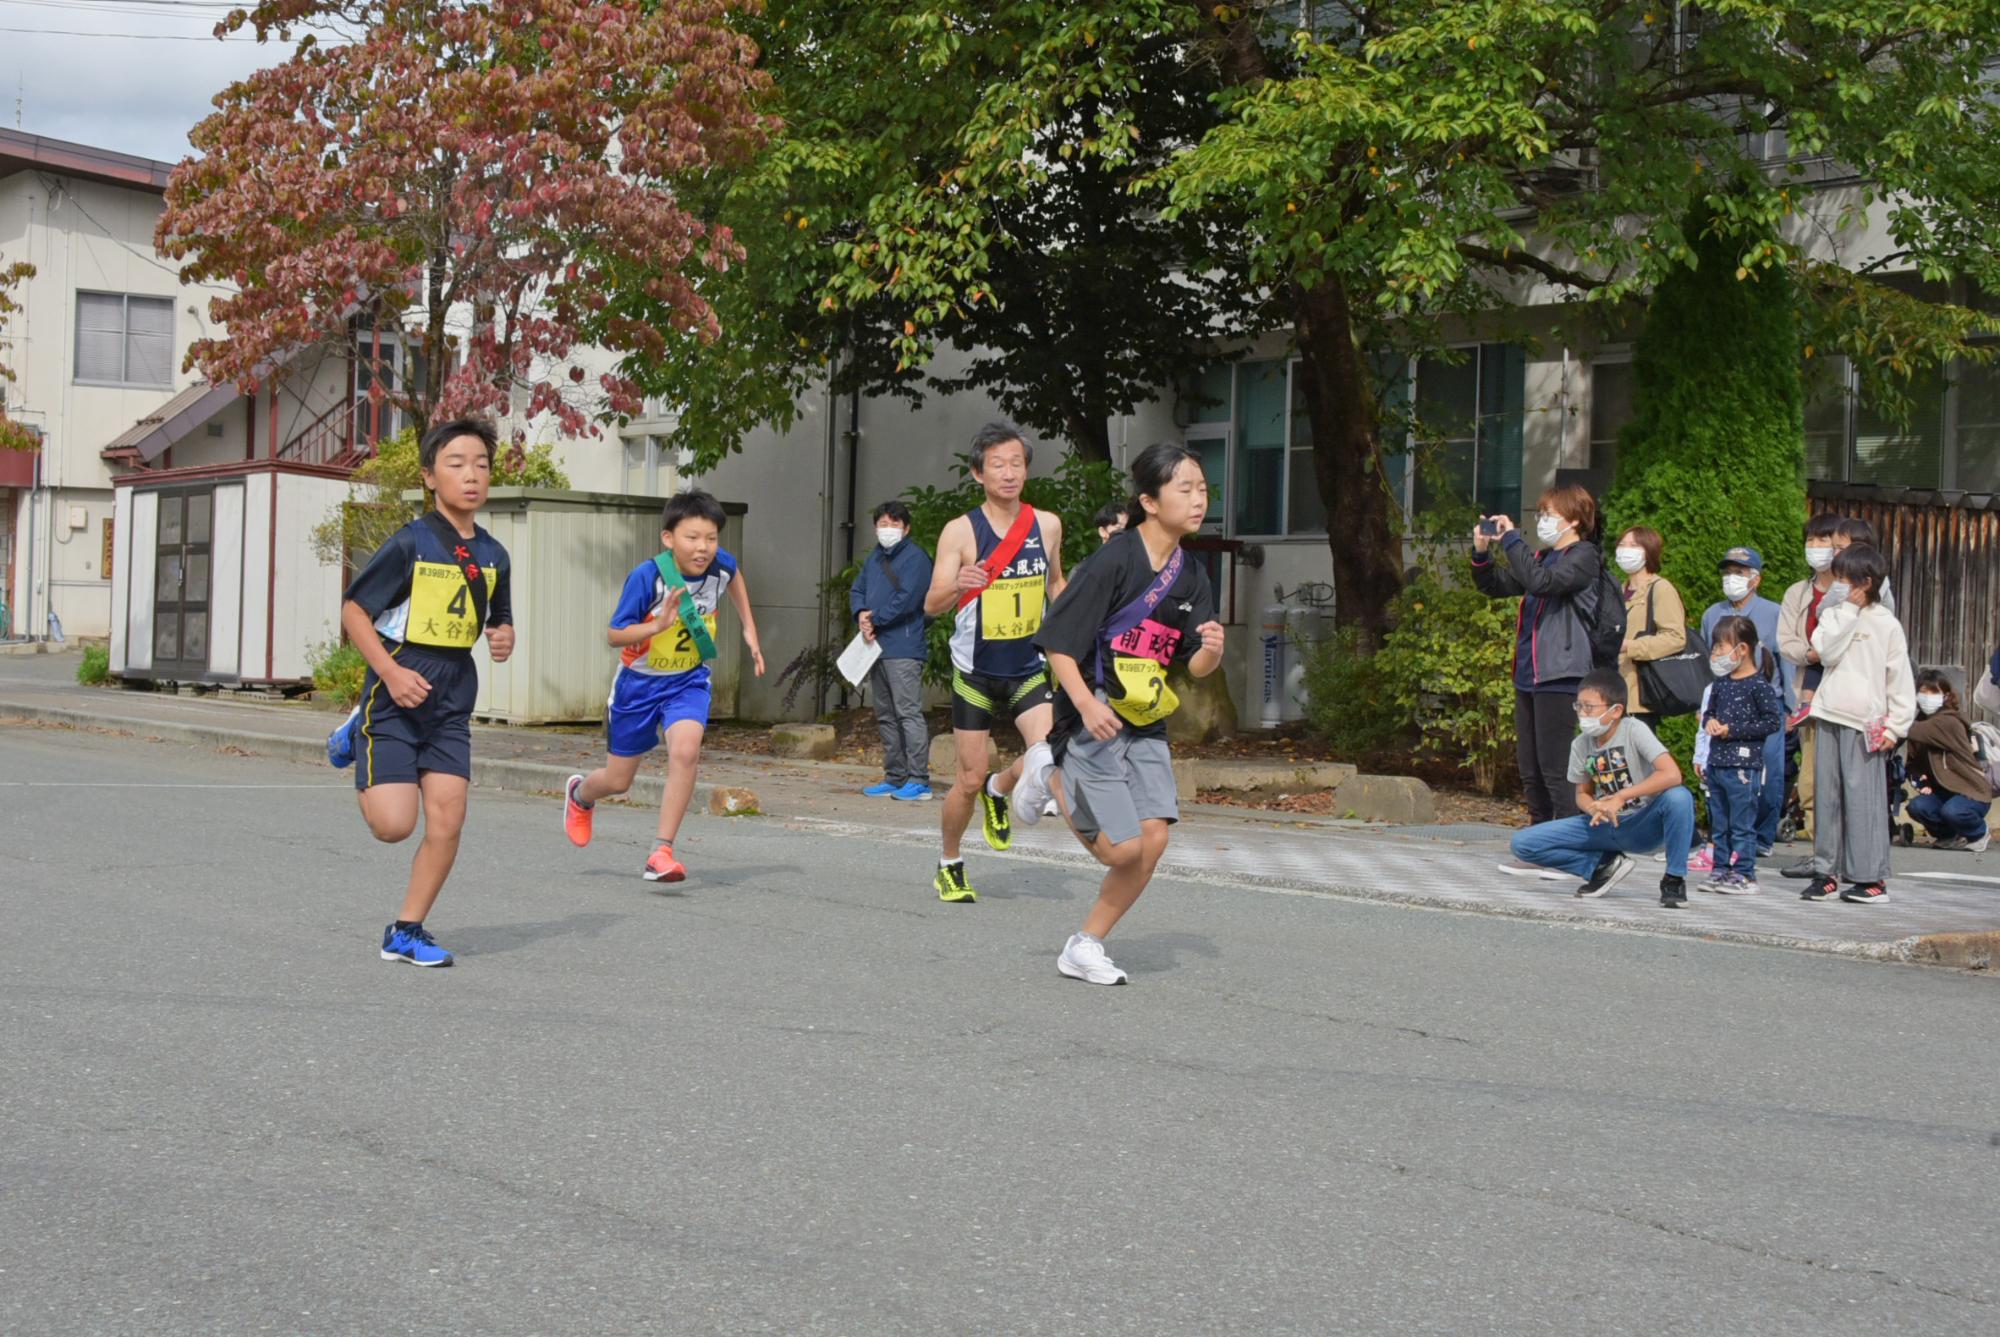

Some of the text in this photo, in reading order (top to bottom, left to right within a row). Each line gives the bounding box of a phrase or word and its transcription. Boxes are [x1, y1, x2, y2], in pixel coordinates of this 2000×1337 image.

[447, 584, 468, 619] 4
[1012, 592, 1022, 618] 1
[675, 628, 692, 652] 2
